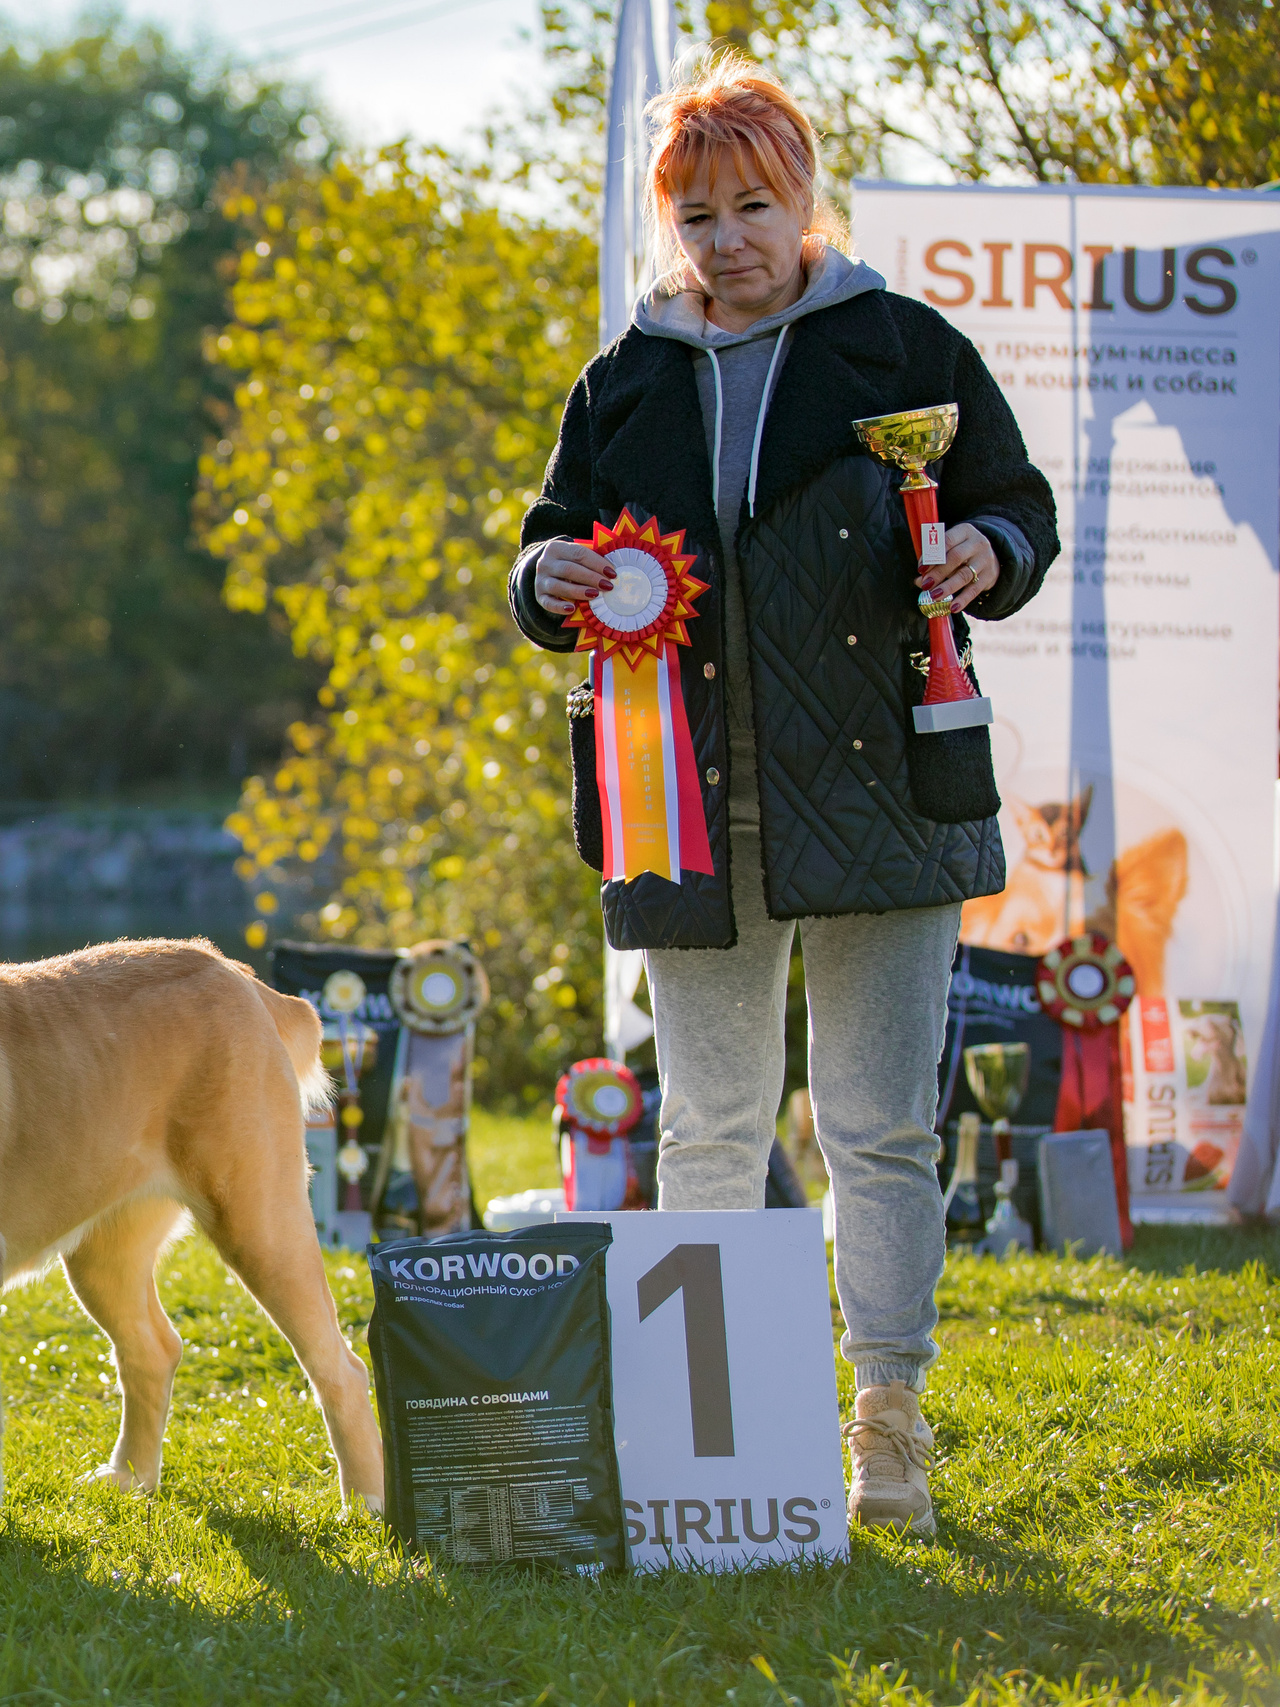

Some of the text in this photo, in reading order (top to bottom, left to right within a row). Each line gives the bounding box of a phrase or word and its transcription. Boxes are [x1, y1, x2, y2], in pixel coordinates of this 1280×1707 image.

[995, 341, 1237, 365] премиум-класса
[1024, 371, 1118, 391] кошек
[1127, 373, 1144, 391] и
[1153, 371, 1237, 395] собак
[1074, 457, 1217, 476] содержание
[1084, 524, 1237, 544] пробиотиков
[949, 970, 1042, 1013] ORWO
[389, 1253, 580, 1281] KORWOOD
[394, 1281, 508, 1298] ПОЛНОРАЦИОННЫЙ
[509, 1284, 545, 1297] СУХОЙ
[409, 1296, 443, 1307] взрослых
[637, 1243, 735, 1457] 1
[405, 1390, 549, 1410] ГОВЯДИНА С ОВОЩАМИ
